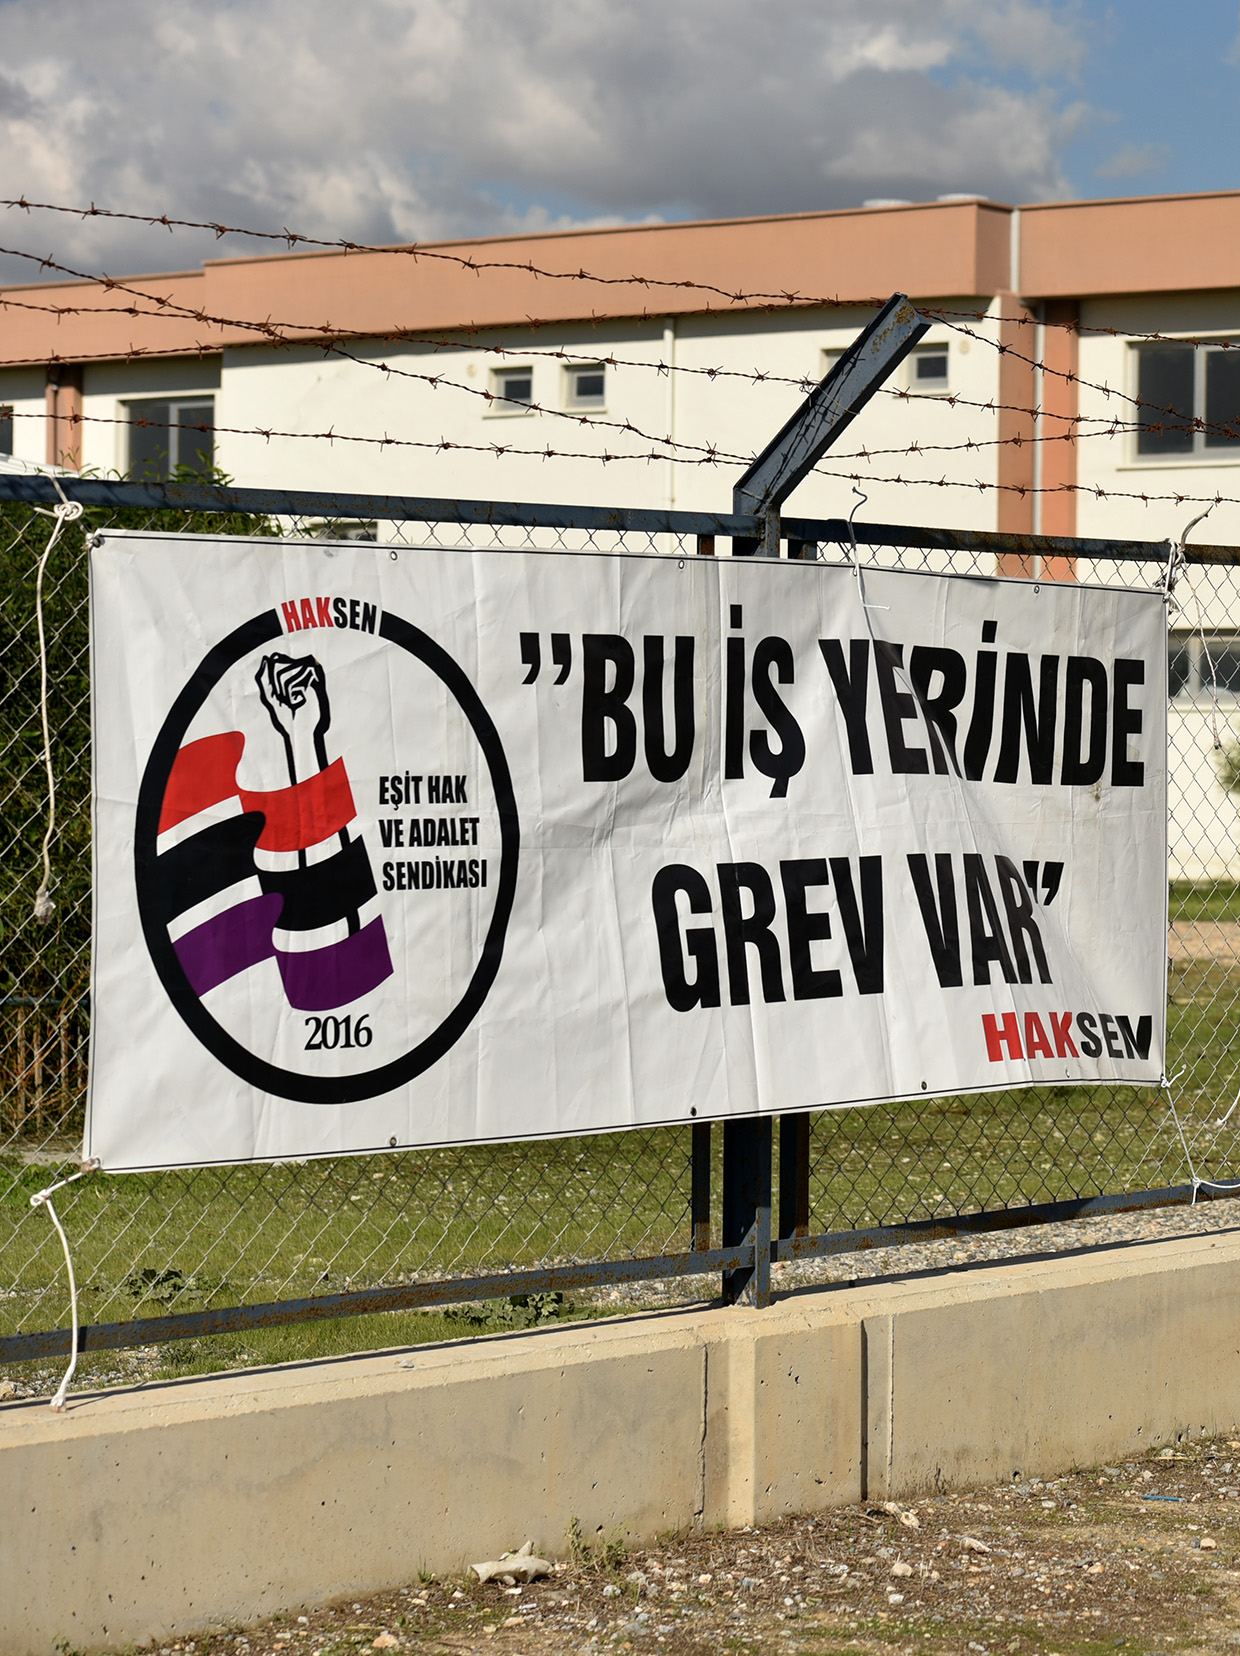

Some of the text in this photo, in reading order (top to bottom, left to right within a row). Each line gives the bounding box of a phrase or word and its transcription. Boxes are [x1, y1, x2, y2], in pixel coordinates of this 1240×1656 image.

[281, 597, 377, 633] HAKSEN
[725, 604, 803, 798] İŞ
[819, 621, 1144, 786] YERİNDE
[379, 775, 468, 811] EŞİT HAK
[380, 817, 480, 847] VE ADALET
[383, 855, 488, 892] SENDİKASI
[652, 856, 884, 1012] GREV
[304, 1014, 373, 1051] 2016
[981, 1012, 1152, 1061] HAKSEN
